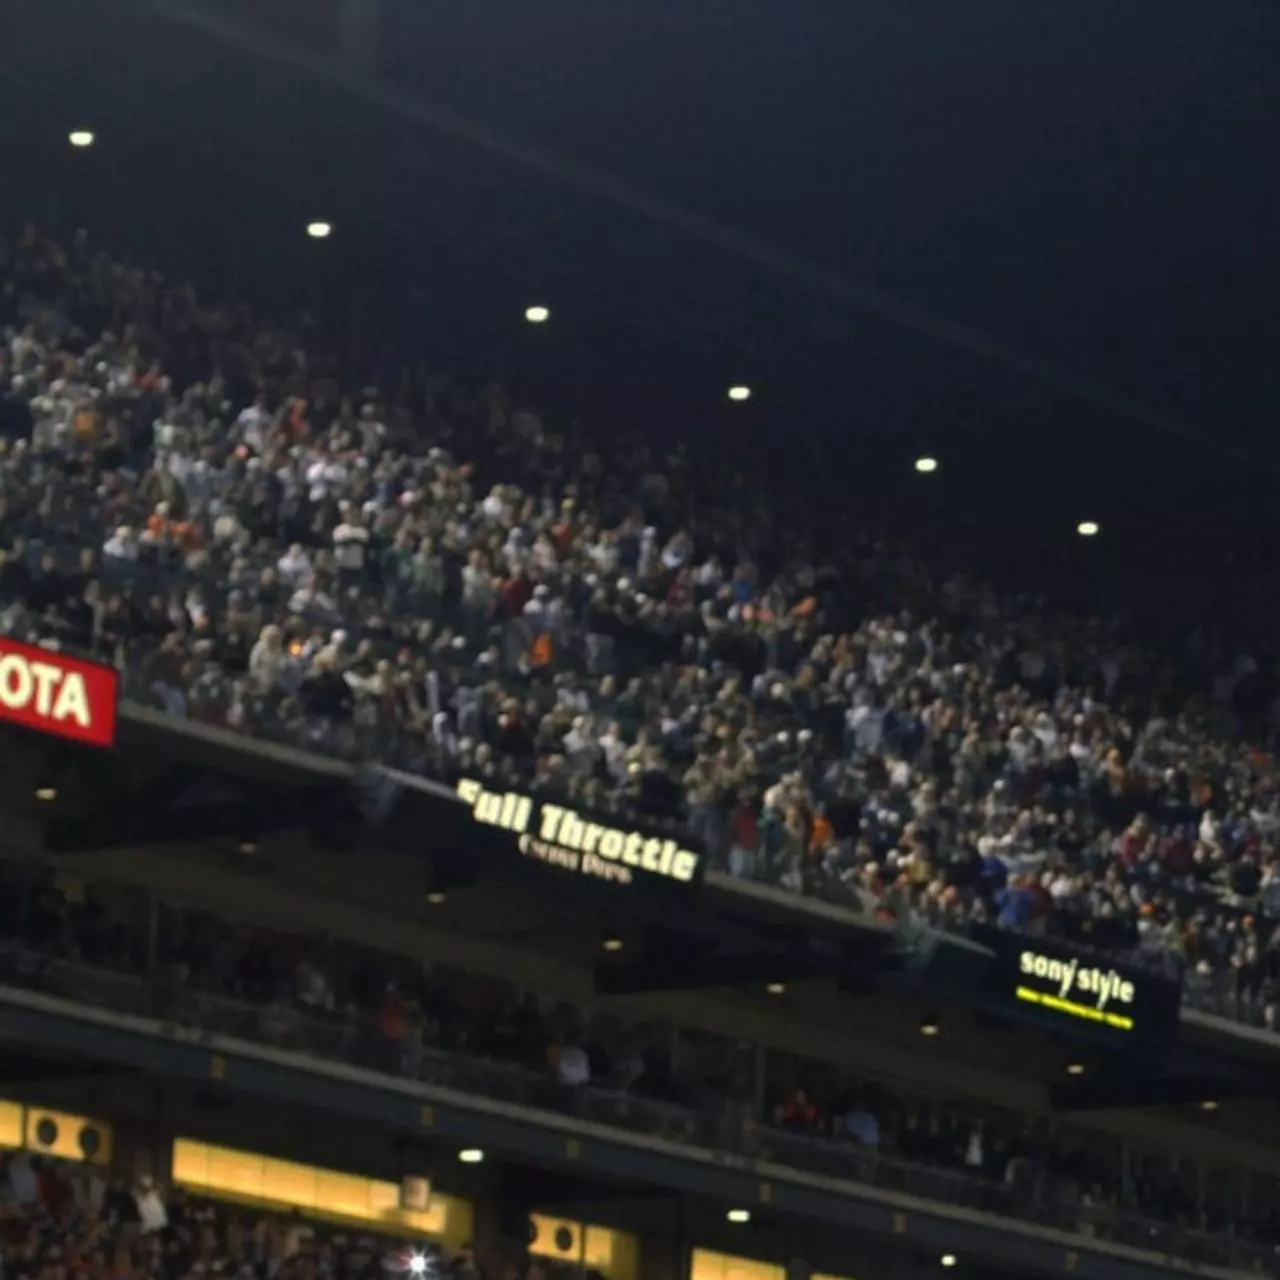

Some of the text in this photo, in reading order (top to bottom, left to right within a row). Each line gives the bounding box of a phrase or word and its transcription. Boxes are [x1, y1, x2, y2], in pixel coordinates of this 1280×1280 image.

[0, 652, 91, 728] OTA
[540, 803, 698, 881] Throttle
[1020, 951, 1077, 998] sony
[1077, 968, 1134, 1010] style
